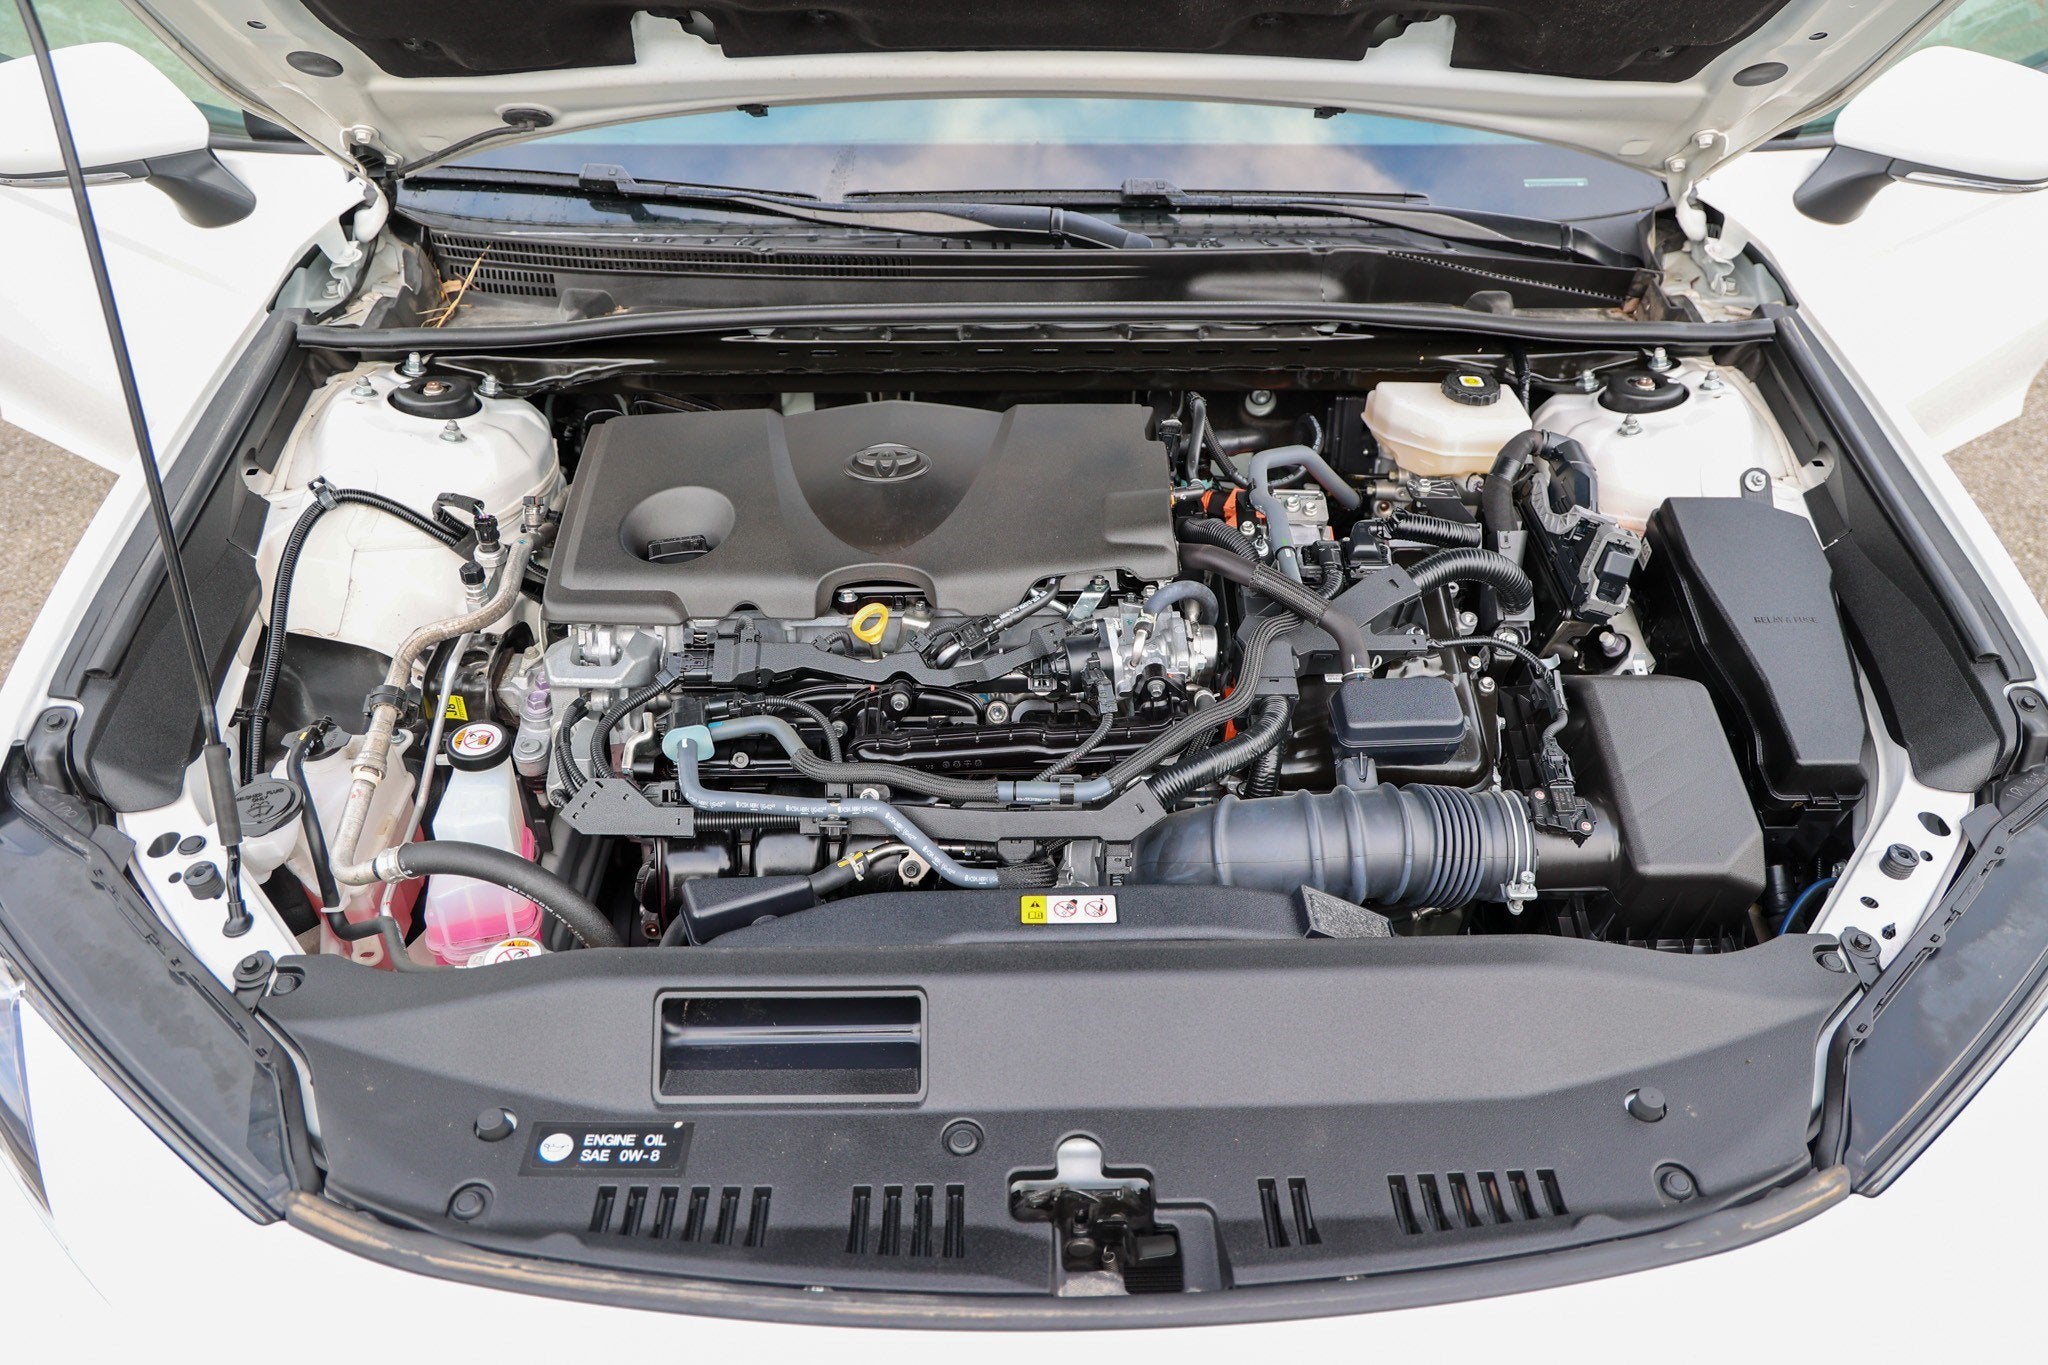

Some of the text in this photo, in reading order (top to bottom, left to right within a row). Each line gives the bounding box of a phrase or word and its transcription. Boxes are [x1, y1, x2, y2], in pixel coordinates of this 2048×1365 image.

[583, 1134, 667, 1146] ENGINE OIL
[580, 1149, 660, 1162] SAE 0W-8
